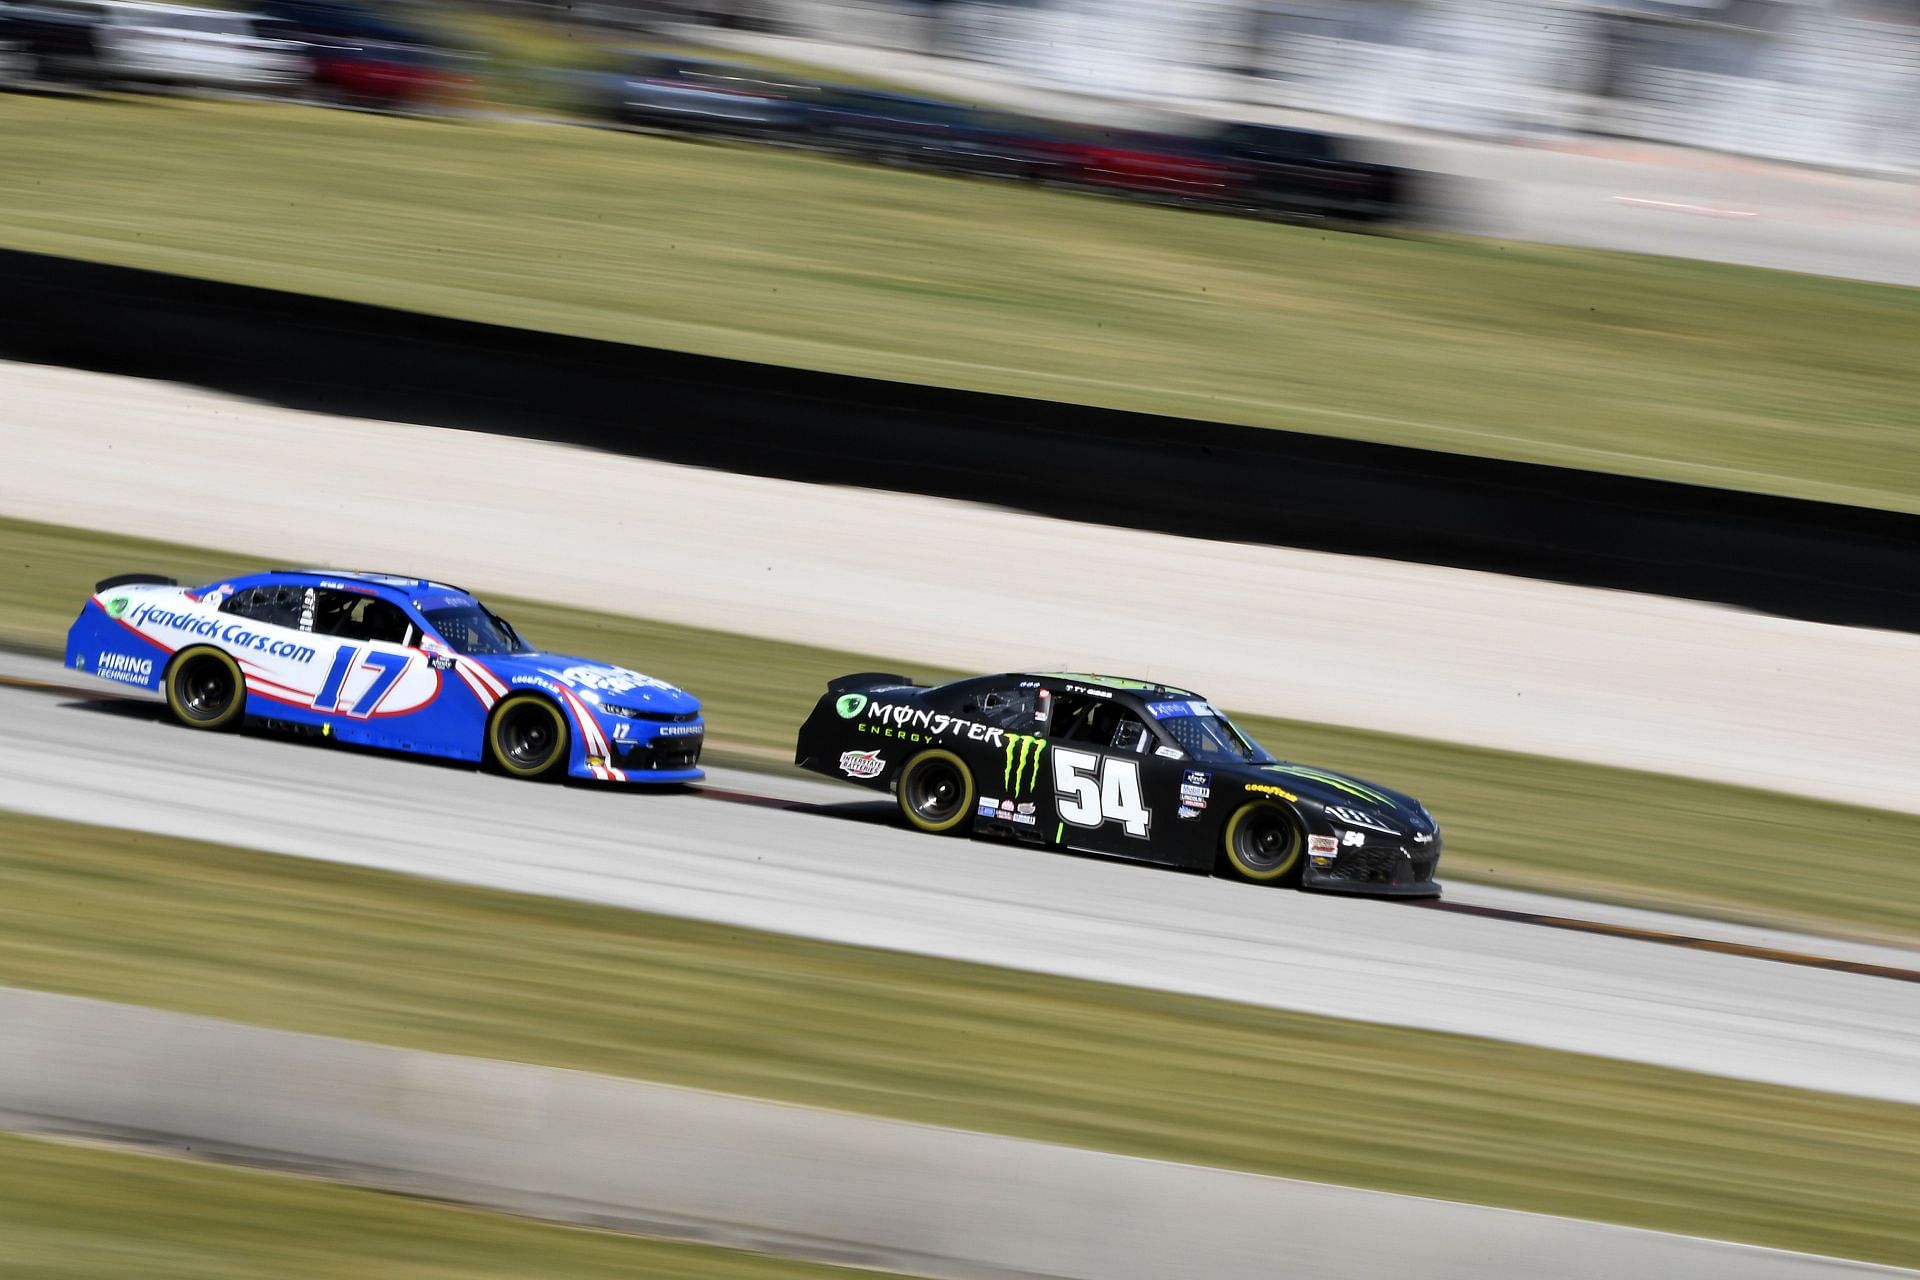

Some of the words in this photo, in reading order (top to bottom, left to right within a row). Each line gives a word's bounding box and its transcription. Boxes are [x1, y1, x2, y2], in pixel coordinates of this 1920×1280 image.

[98, 651, 153, 676] HIRING
[96, 666, 151, 686] TECHNICIANS
[312, 645, 412, 719] 17
[613, 722, 630, 739] 17
[858, 722, 934, 745] ENERGY
[842, 754, 883, 769] INTERSTATE
[843, 762, 879, 775] BATTERIES
[1051, 746, 1152, 840] 54
[1245, 783, 1298, 803] GOODYEAR
[1342, 830, 1365, 847] 54
